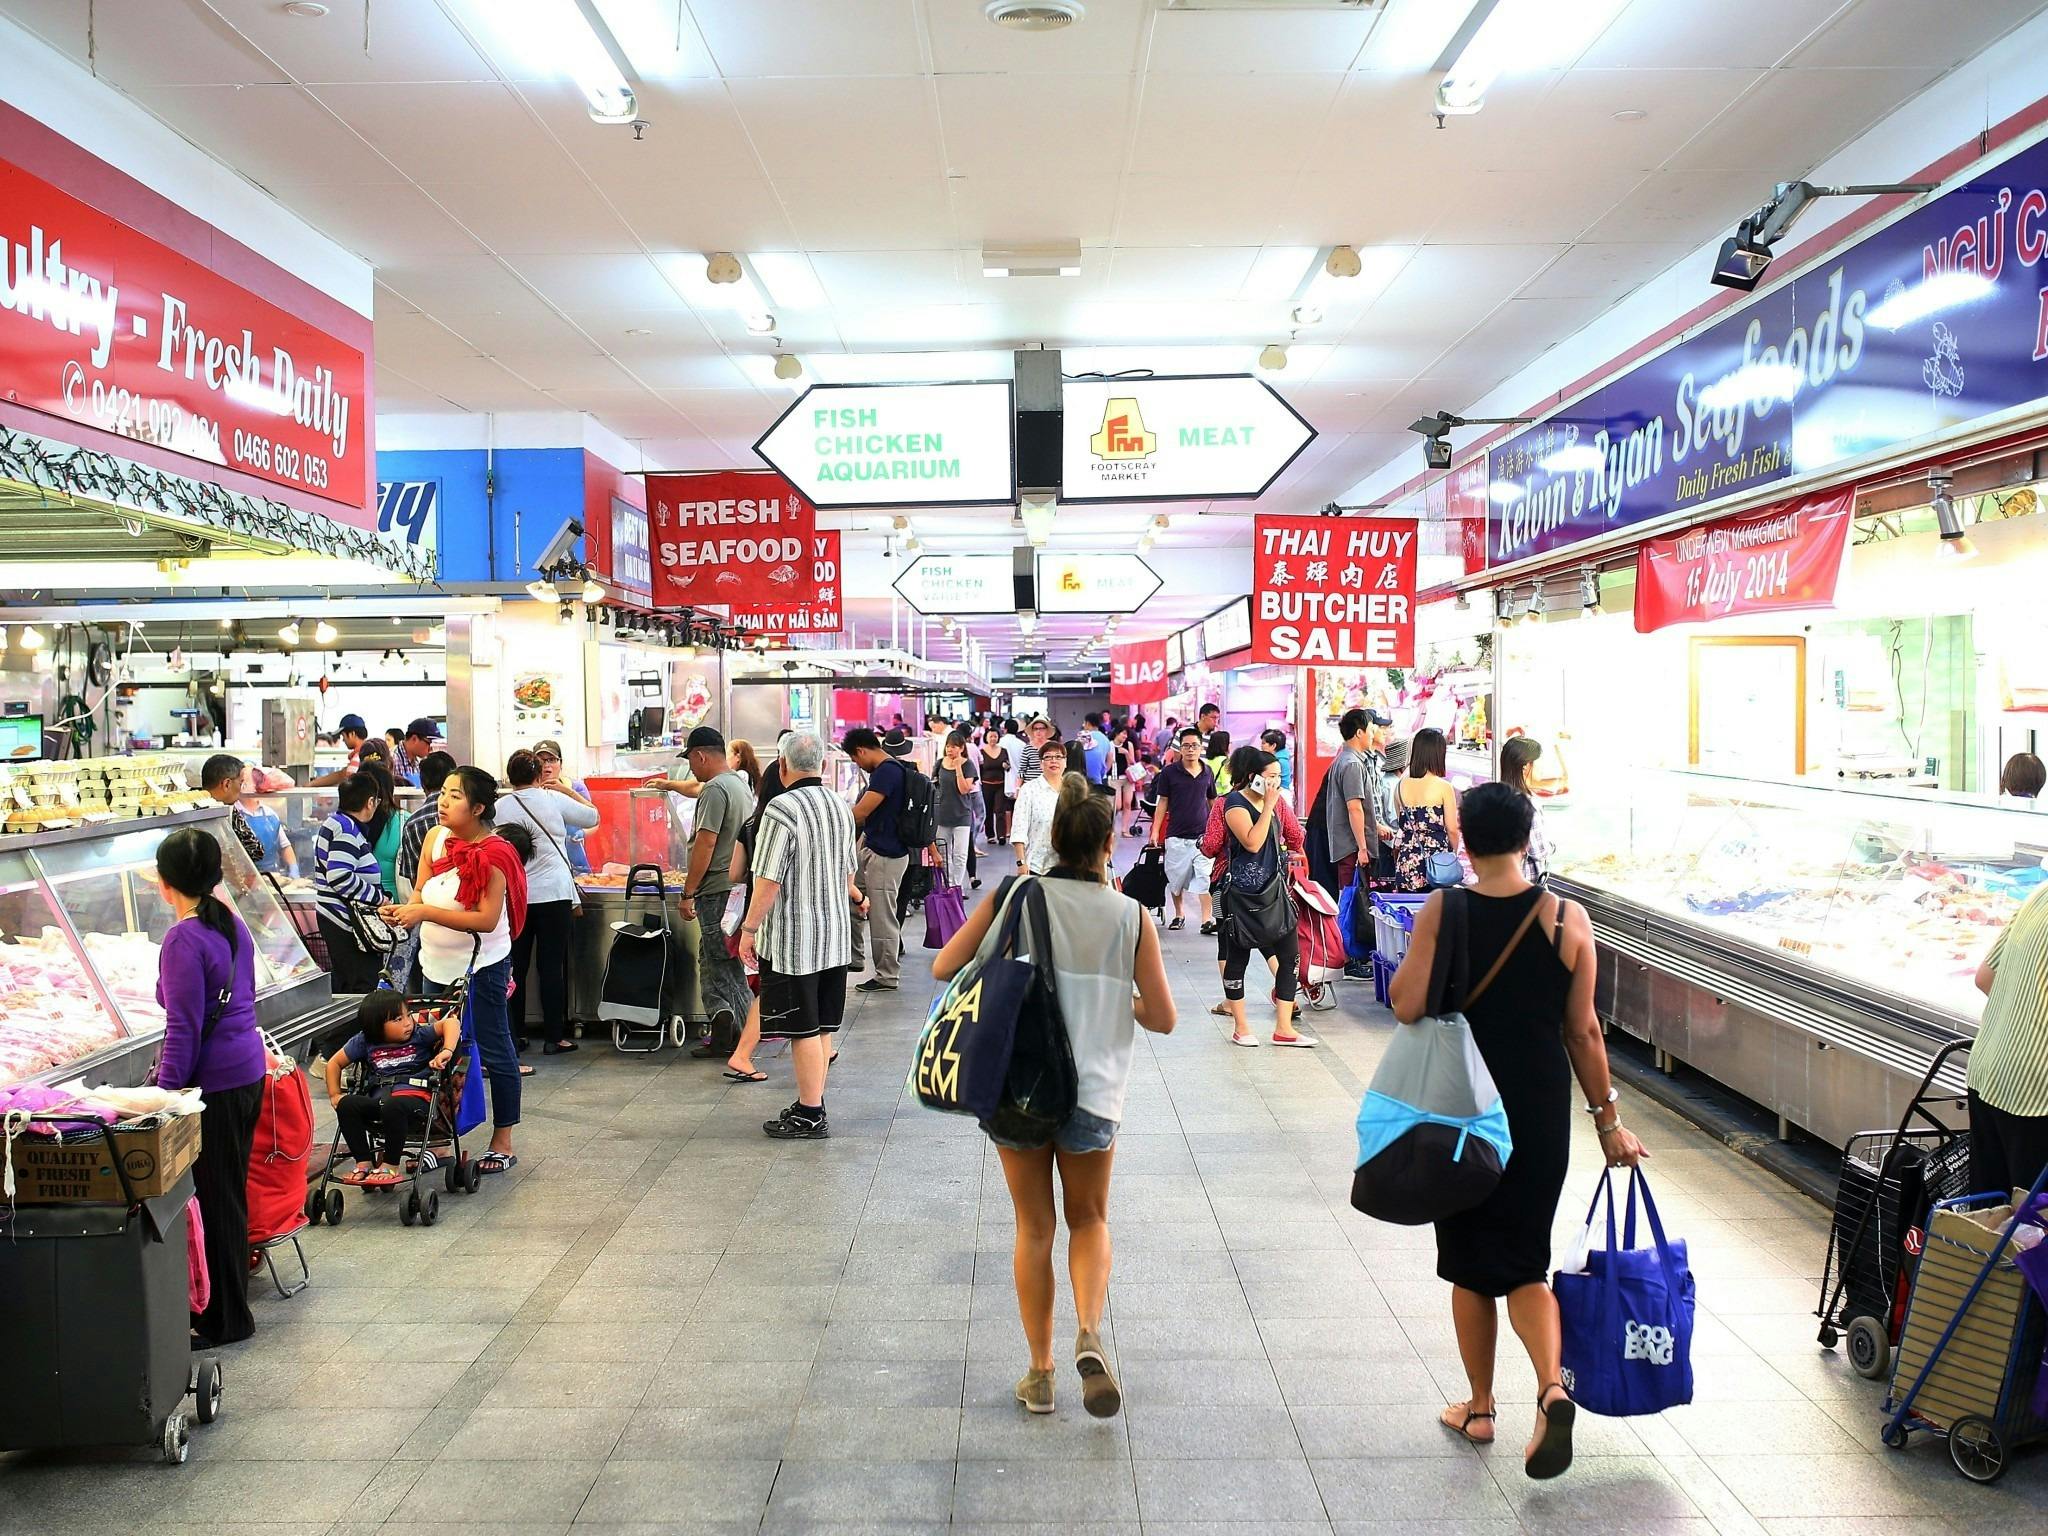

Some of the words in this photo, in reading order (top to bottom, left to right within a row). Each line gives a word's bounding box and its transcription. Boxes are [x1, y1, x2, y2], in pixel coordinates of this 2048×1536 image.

[2016, 189, 2048, 267] C
[157, 292, 262, 402] Fresh
[270, 346, 349, 458] Daily
[814, 408, 877, 429] FISH
[91, 379, 142, 435] 0421
[234, 428, 272, 471] 0466
[274, 444, 300, 481] 602
[303, 456, 328, 489] 053
[814, 433, 943, 455] CHICKEN
[1178, 426, 1255, 447] MEAT
[817, 458, 960, 482] AQUARIUM
[1091, 462, 1156, 471] FOOTSCRAY
[1101, 472, 1148, 481] MARKET
[1676, 468, 1708, 502] Daily
[1710, 458, 1748, 491] Fresh
[1750, 442, 1780, 479] Fish
[1497, 468, 1567, 558] Kelvin
[1571, 466, 1585, 518] &
[1588, 415, 1664, 518] Ryan
[678, 498, 780, 527] FRESH
[1262, 528, 1332, 557] THAI
[1346, 530, 1413, 558] HUY
[1675, 533, 1708, 563] UNDER
[1706, 529, 1730, 555] NEW
[1731, 511, 1801, 549] MANAGMENT
[659, 537, 803, 567] SEAFOOD
[921, 566, 953, 576] FISH
[921, 578, 983, 588] CHICKEN
[1268, 559, 1399, 590] 泰輝肉店
[1686, 566, 1702, 608] 15
[1700, 563, 1742, 613] July
[1744, 550, 1789, 600] 2014
[733, 613, 764, 630] KHAI
[767, 613, 785, 630] KY
[812, 607, 838, 628] SẢN
[1260, 591, 1408, 624] BUTCHER
[1269, 625, 1398, 662] SALE
[27, 1151, 100, 1165] QUALITY
[37, 1167, 91, 1181] FRESH
[39, 1184, 91, 1198] FRUIT
